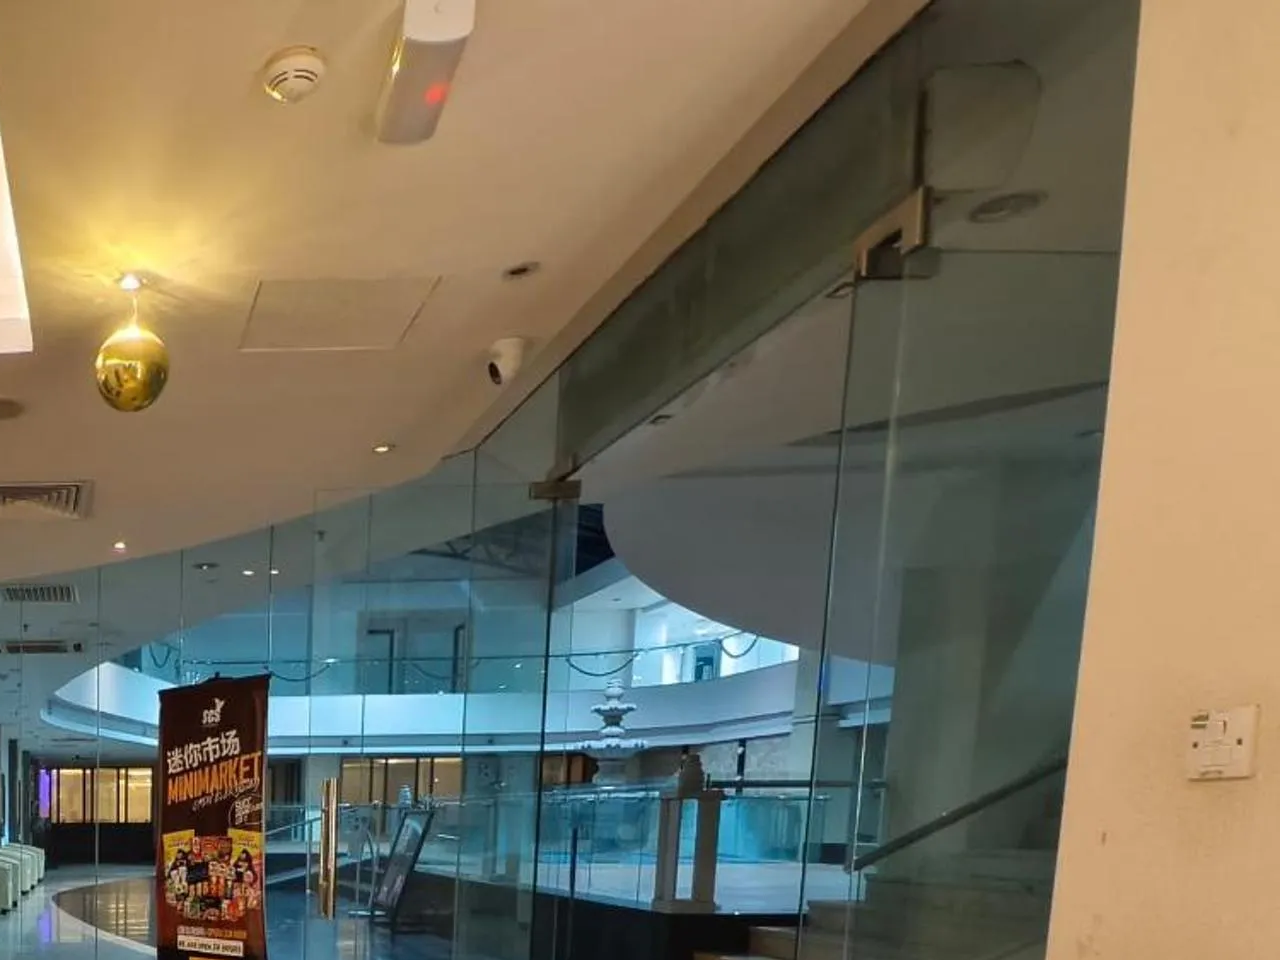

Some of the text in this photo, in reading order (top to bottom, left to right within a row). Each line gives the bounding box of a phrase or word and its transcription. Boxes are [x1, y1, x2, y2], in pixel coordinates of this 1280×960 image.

[167, 729, 240, 774] 迷你市场
[166, 750, 261, 805] MINIMARKET
